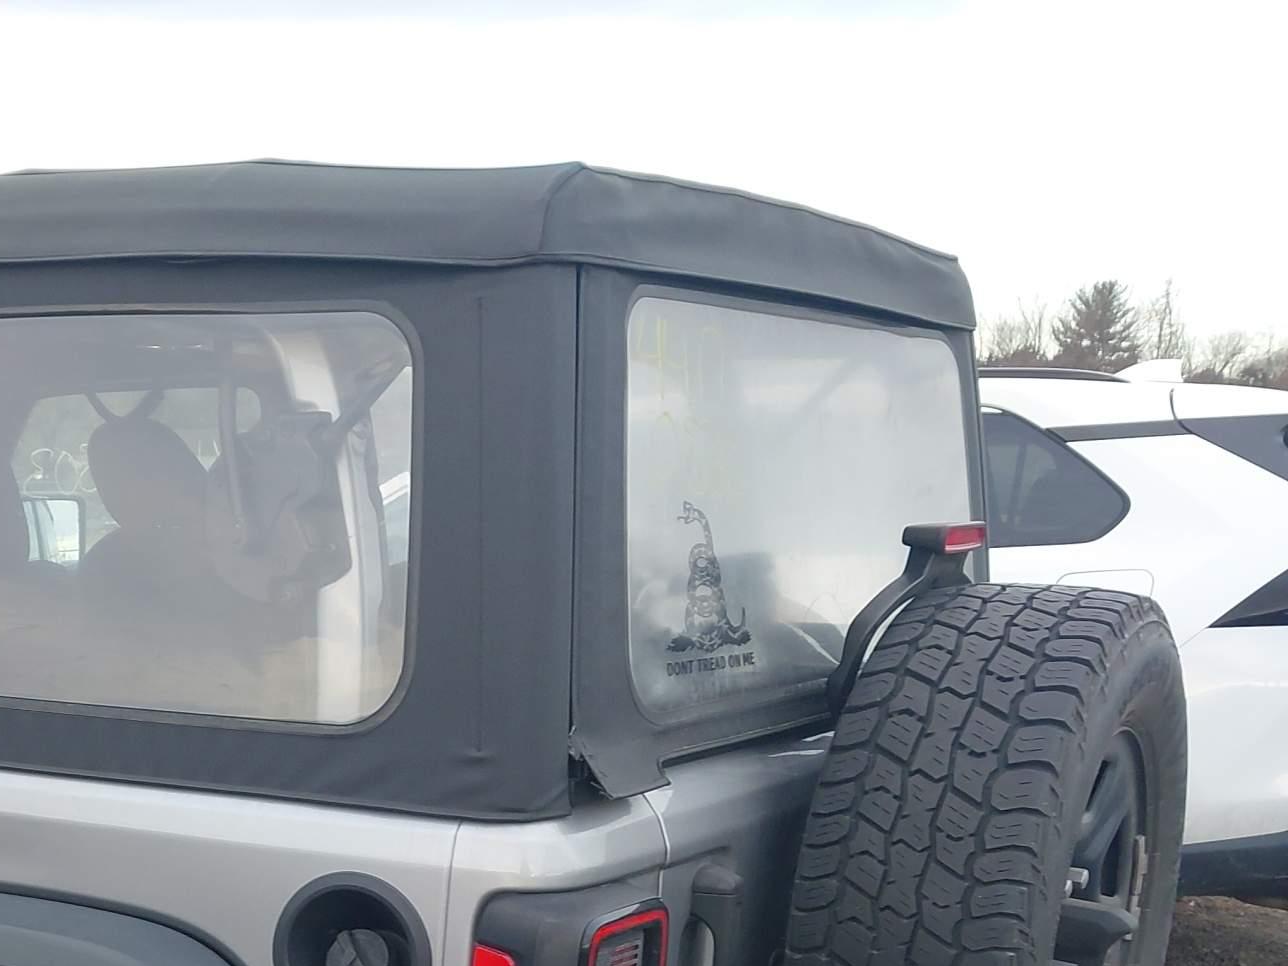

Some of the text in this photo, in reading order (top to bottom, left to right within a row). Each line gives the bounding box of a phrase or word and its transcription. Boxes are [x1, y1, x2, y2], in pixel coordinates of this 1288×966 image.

[667, 652, 756, 676] DONT TREAD ON ME
